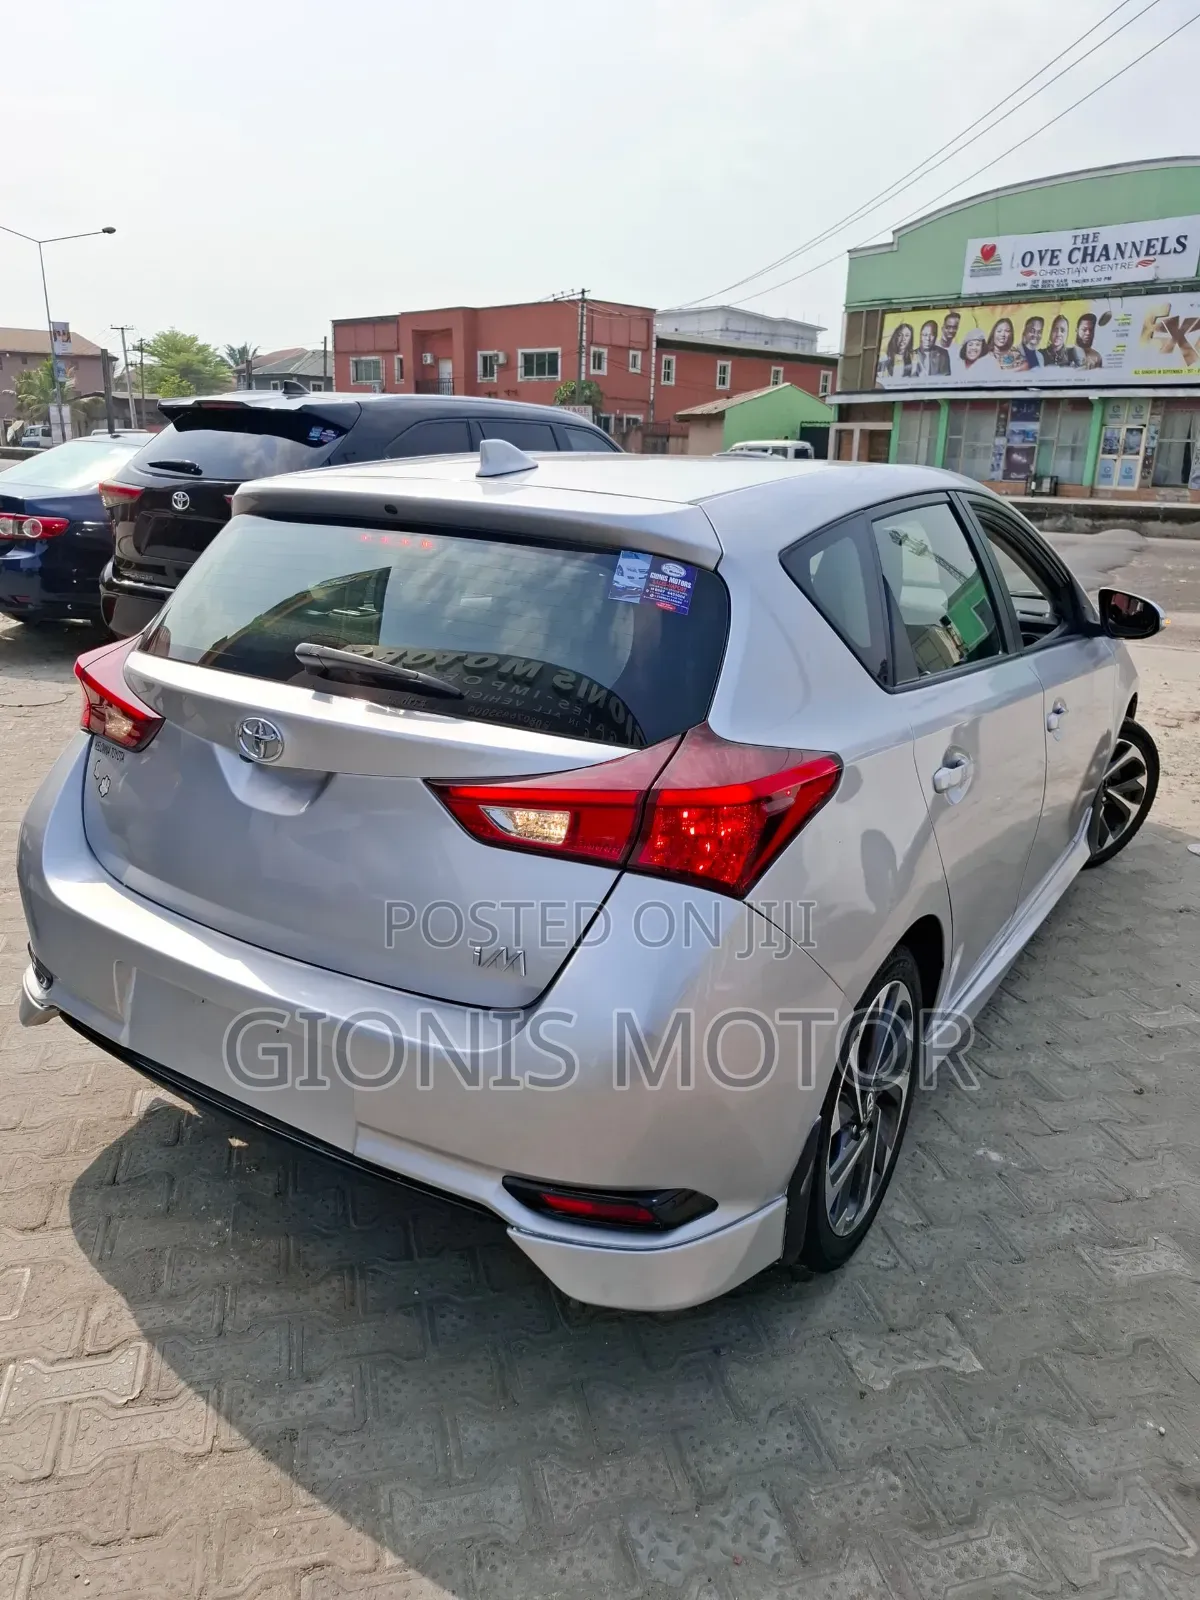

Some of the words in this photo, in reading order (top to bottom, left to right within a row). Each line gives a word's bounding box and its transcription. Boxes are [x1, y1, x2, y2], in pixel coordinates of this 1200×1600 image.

[1072, 232, 1101, 246] THE
[1067, 234, 1189, 266] CHANNELS
[1038, 267, 1088, 278] CHRISTIAN
[1093, 260, 1135, 273] CENTRE
[669, 576, 692, 589] MOTORS
